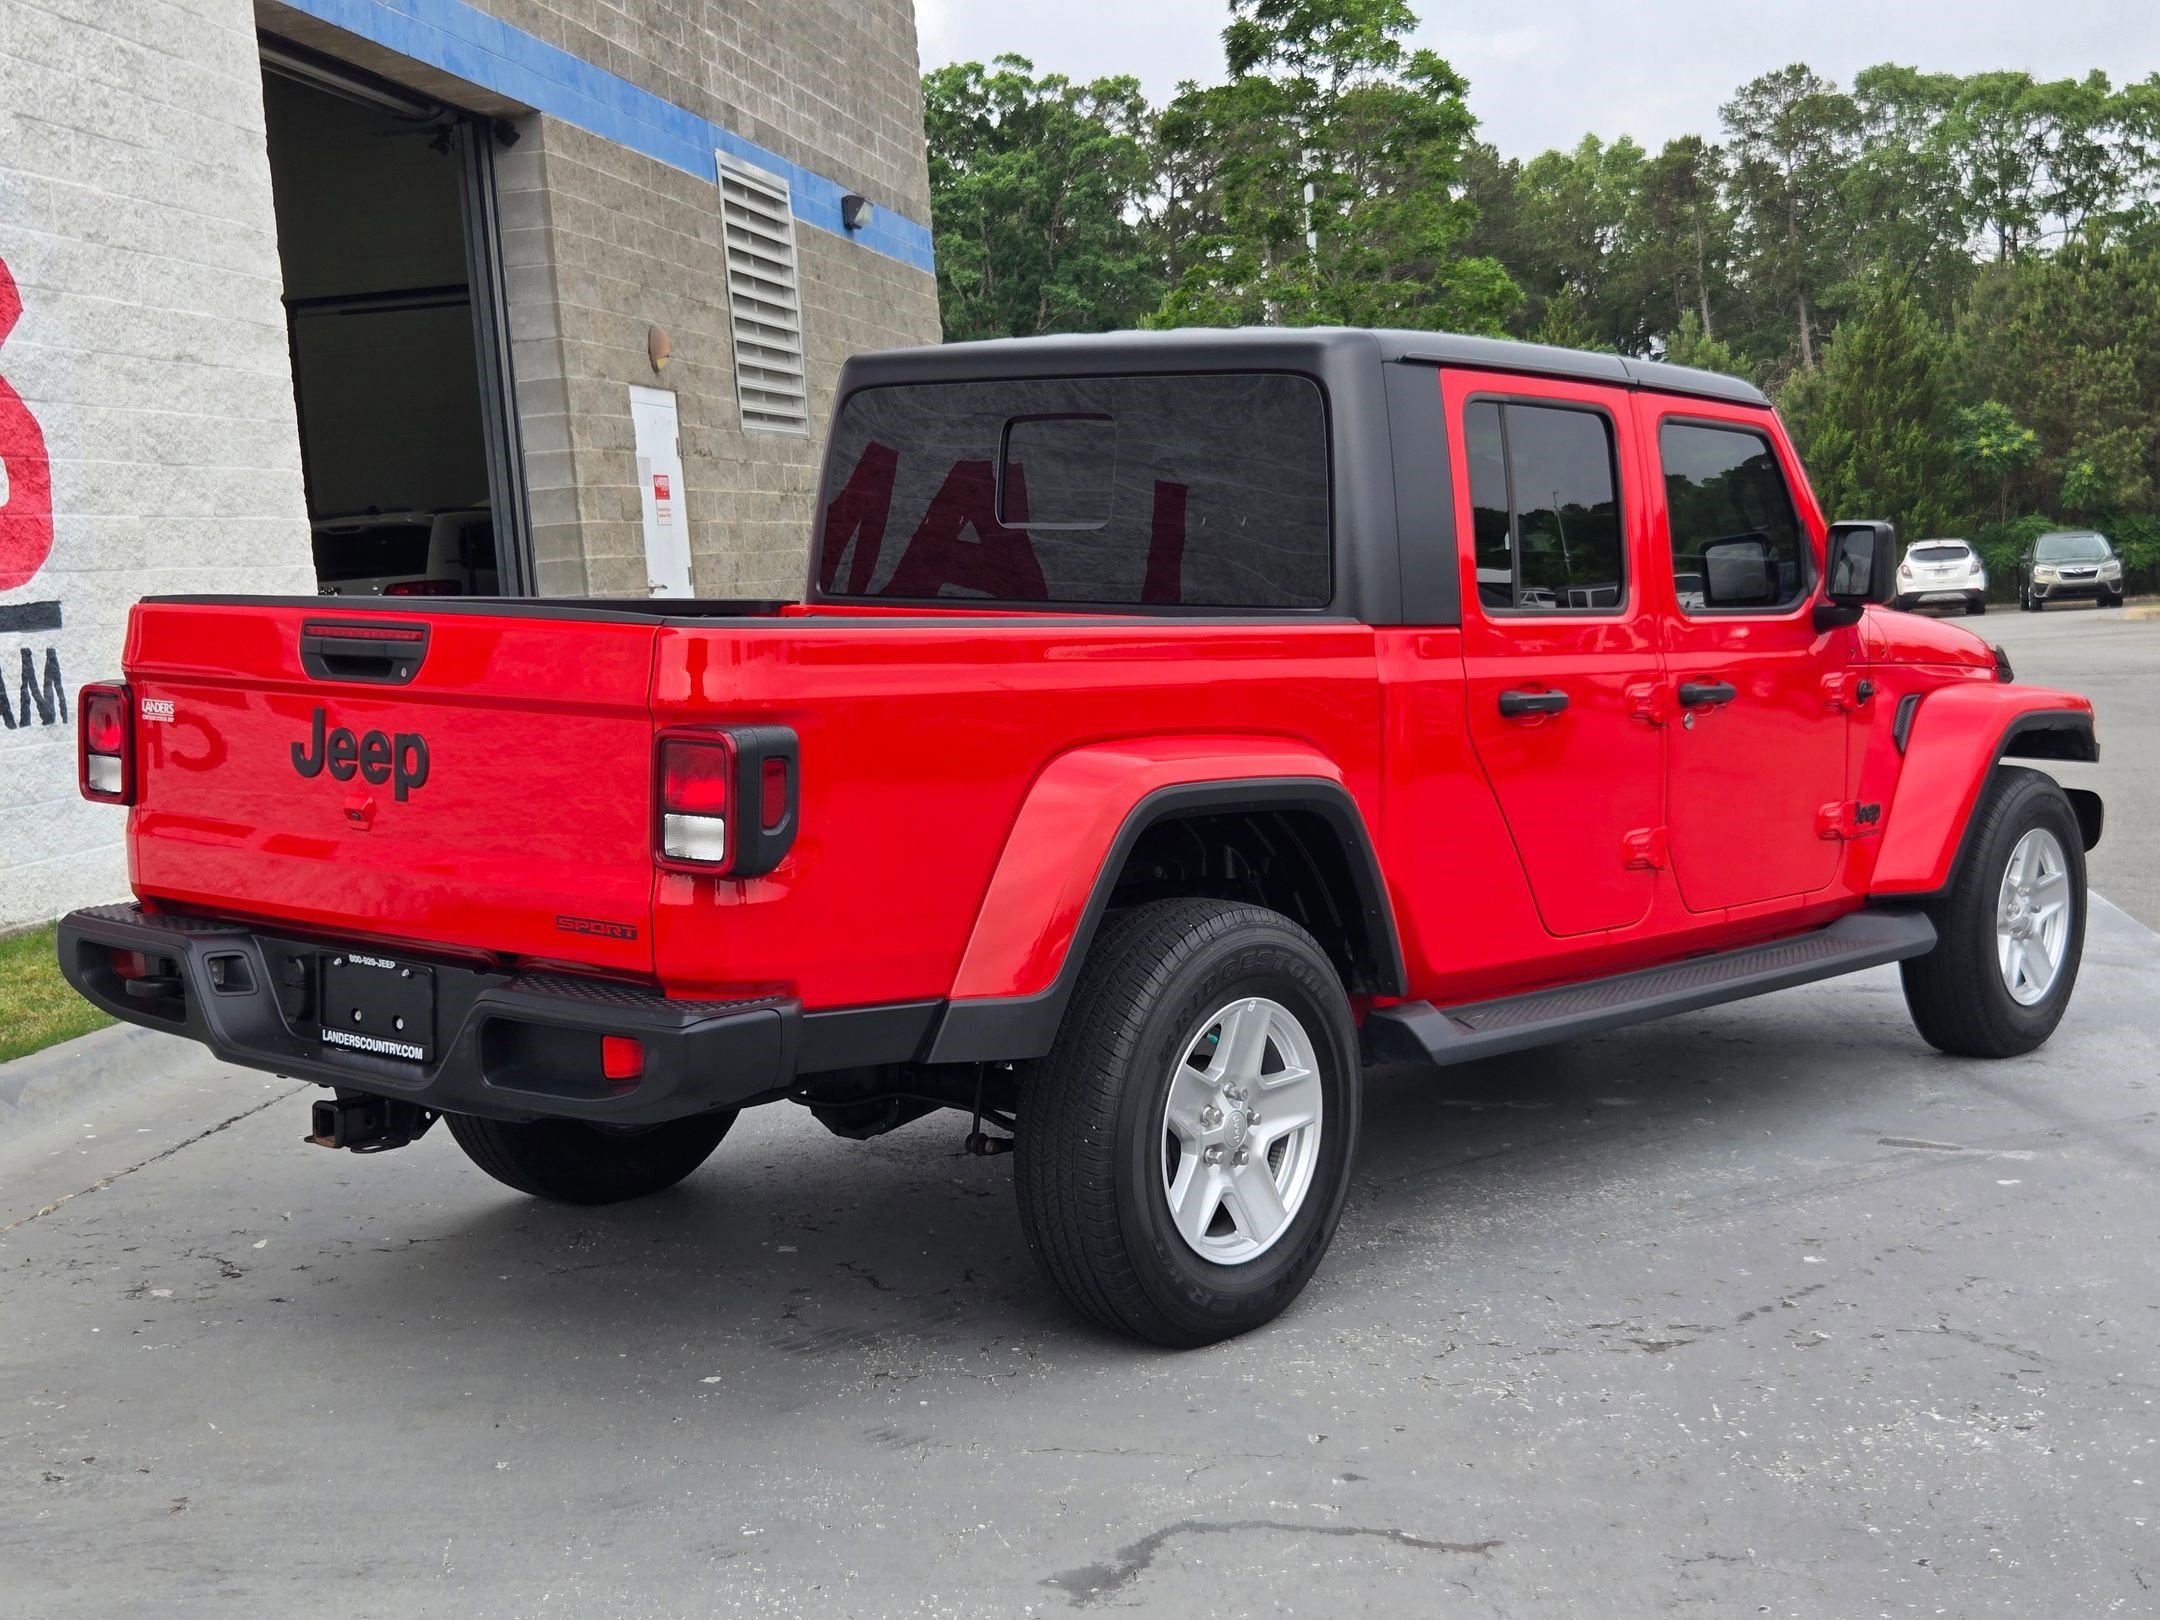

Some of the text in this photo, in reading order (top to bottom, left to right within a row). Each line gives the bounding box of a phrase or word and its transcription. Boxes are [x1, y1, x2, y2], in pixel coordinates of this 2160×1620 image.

[142, 699, 174, 715] LANDERS
[291, 707, 430, 803] Jeep
[1854, 801, 1881, 826] Jeep
[556, 915, 637, 940] SPORT
[322, 1029, 423, 1060] LANDERSCOUNTRY.COM
